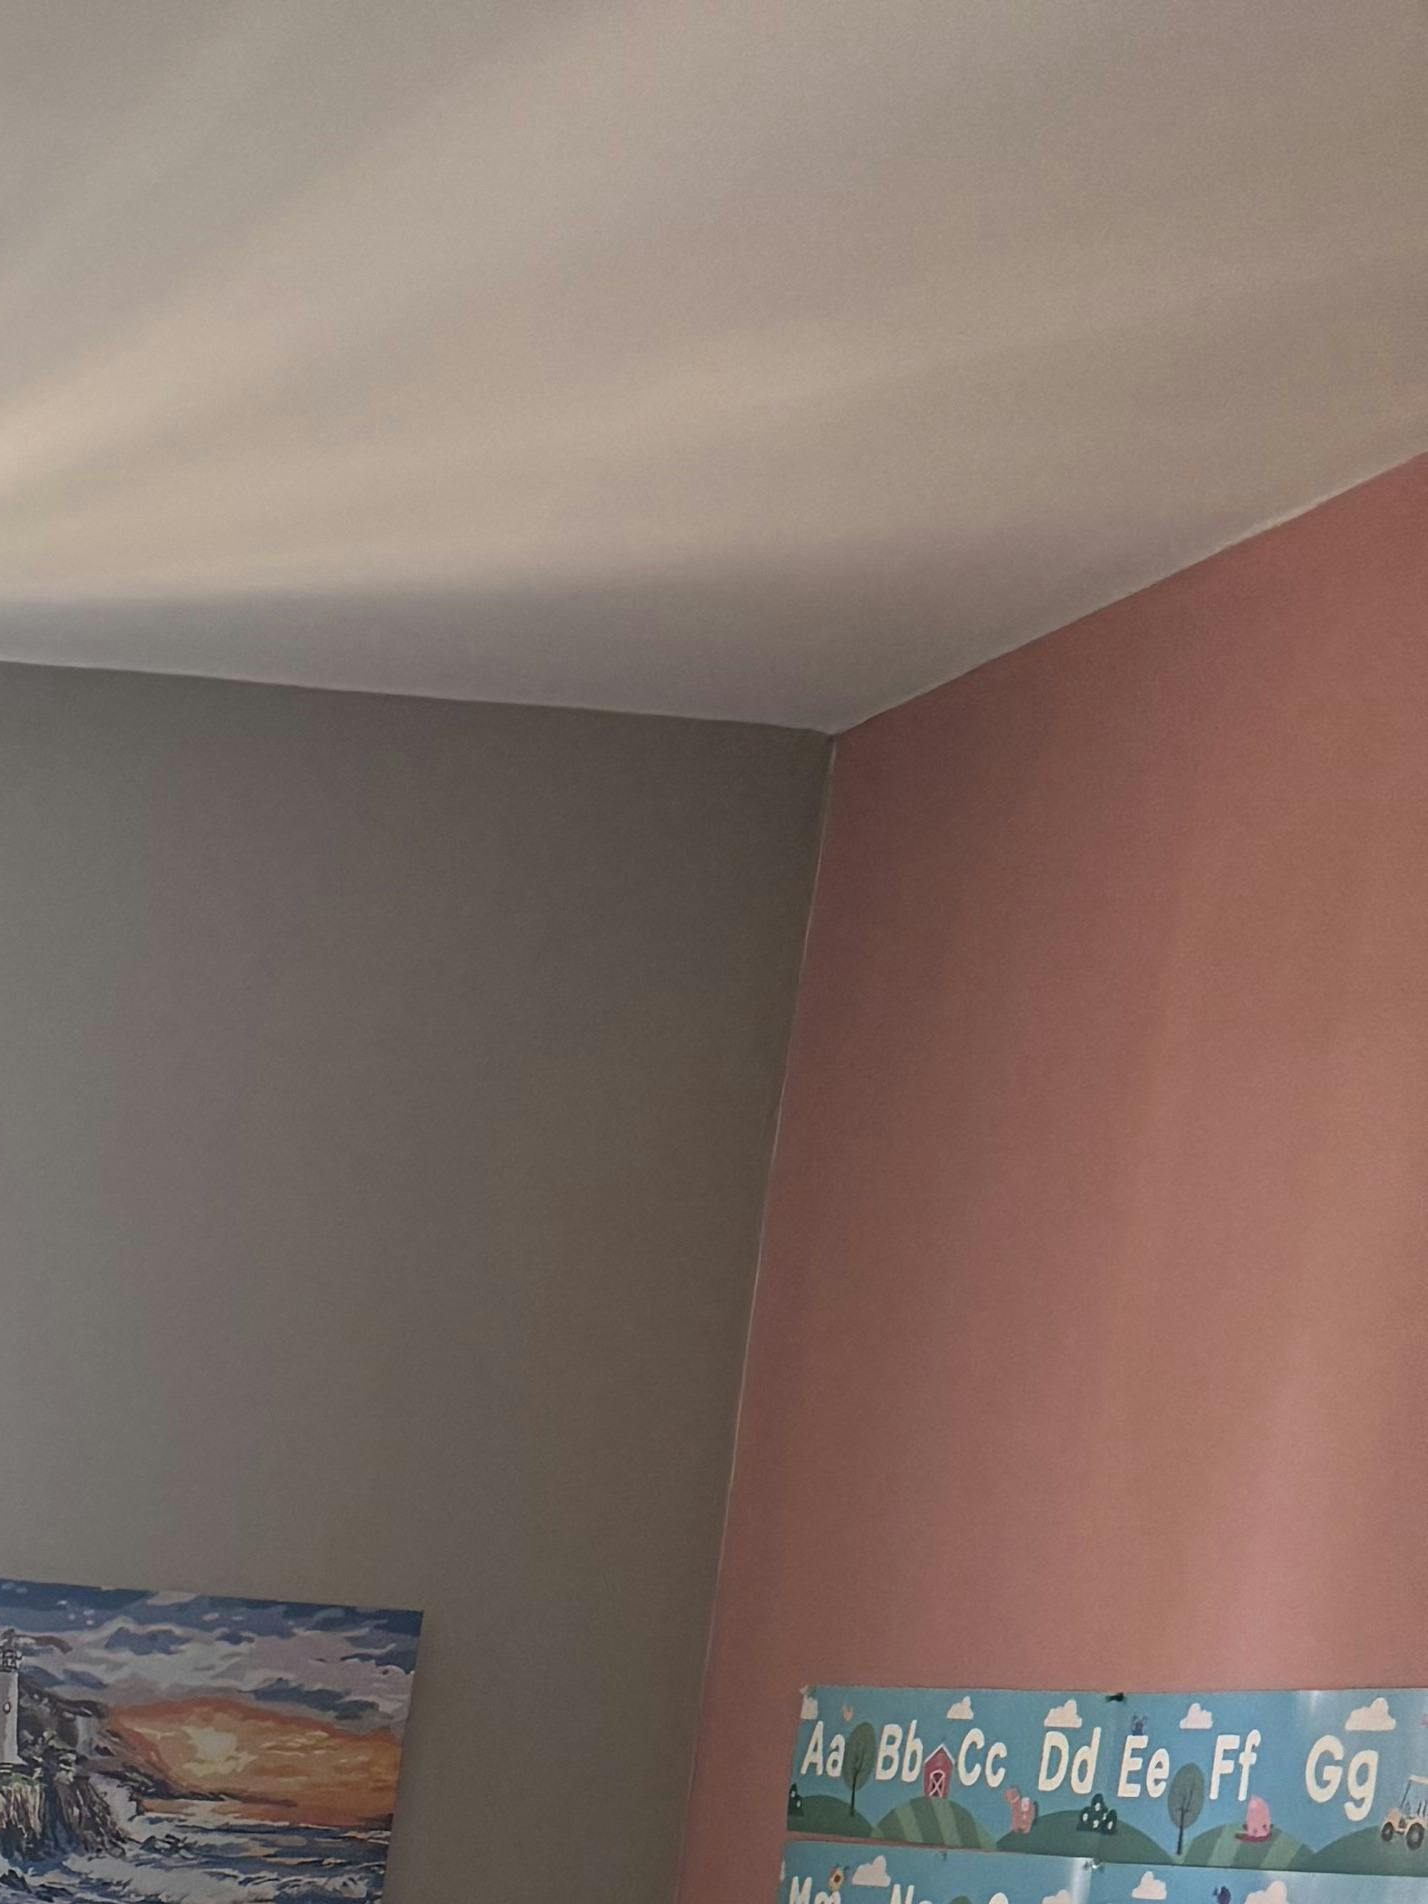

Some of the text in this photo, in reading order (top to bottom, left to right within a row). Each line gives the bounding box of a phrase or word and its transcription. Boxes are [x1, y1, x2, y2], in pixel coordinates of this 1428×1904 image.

[800, 1720, 1378, 1822] Aa Bb Cc Dd Ee Ff Gg
